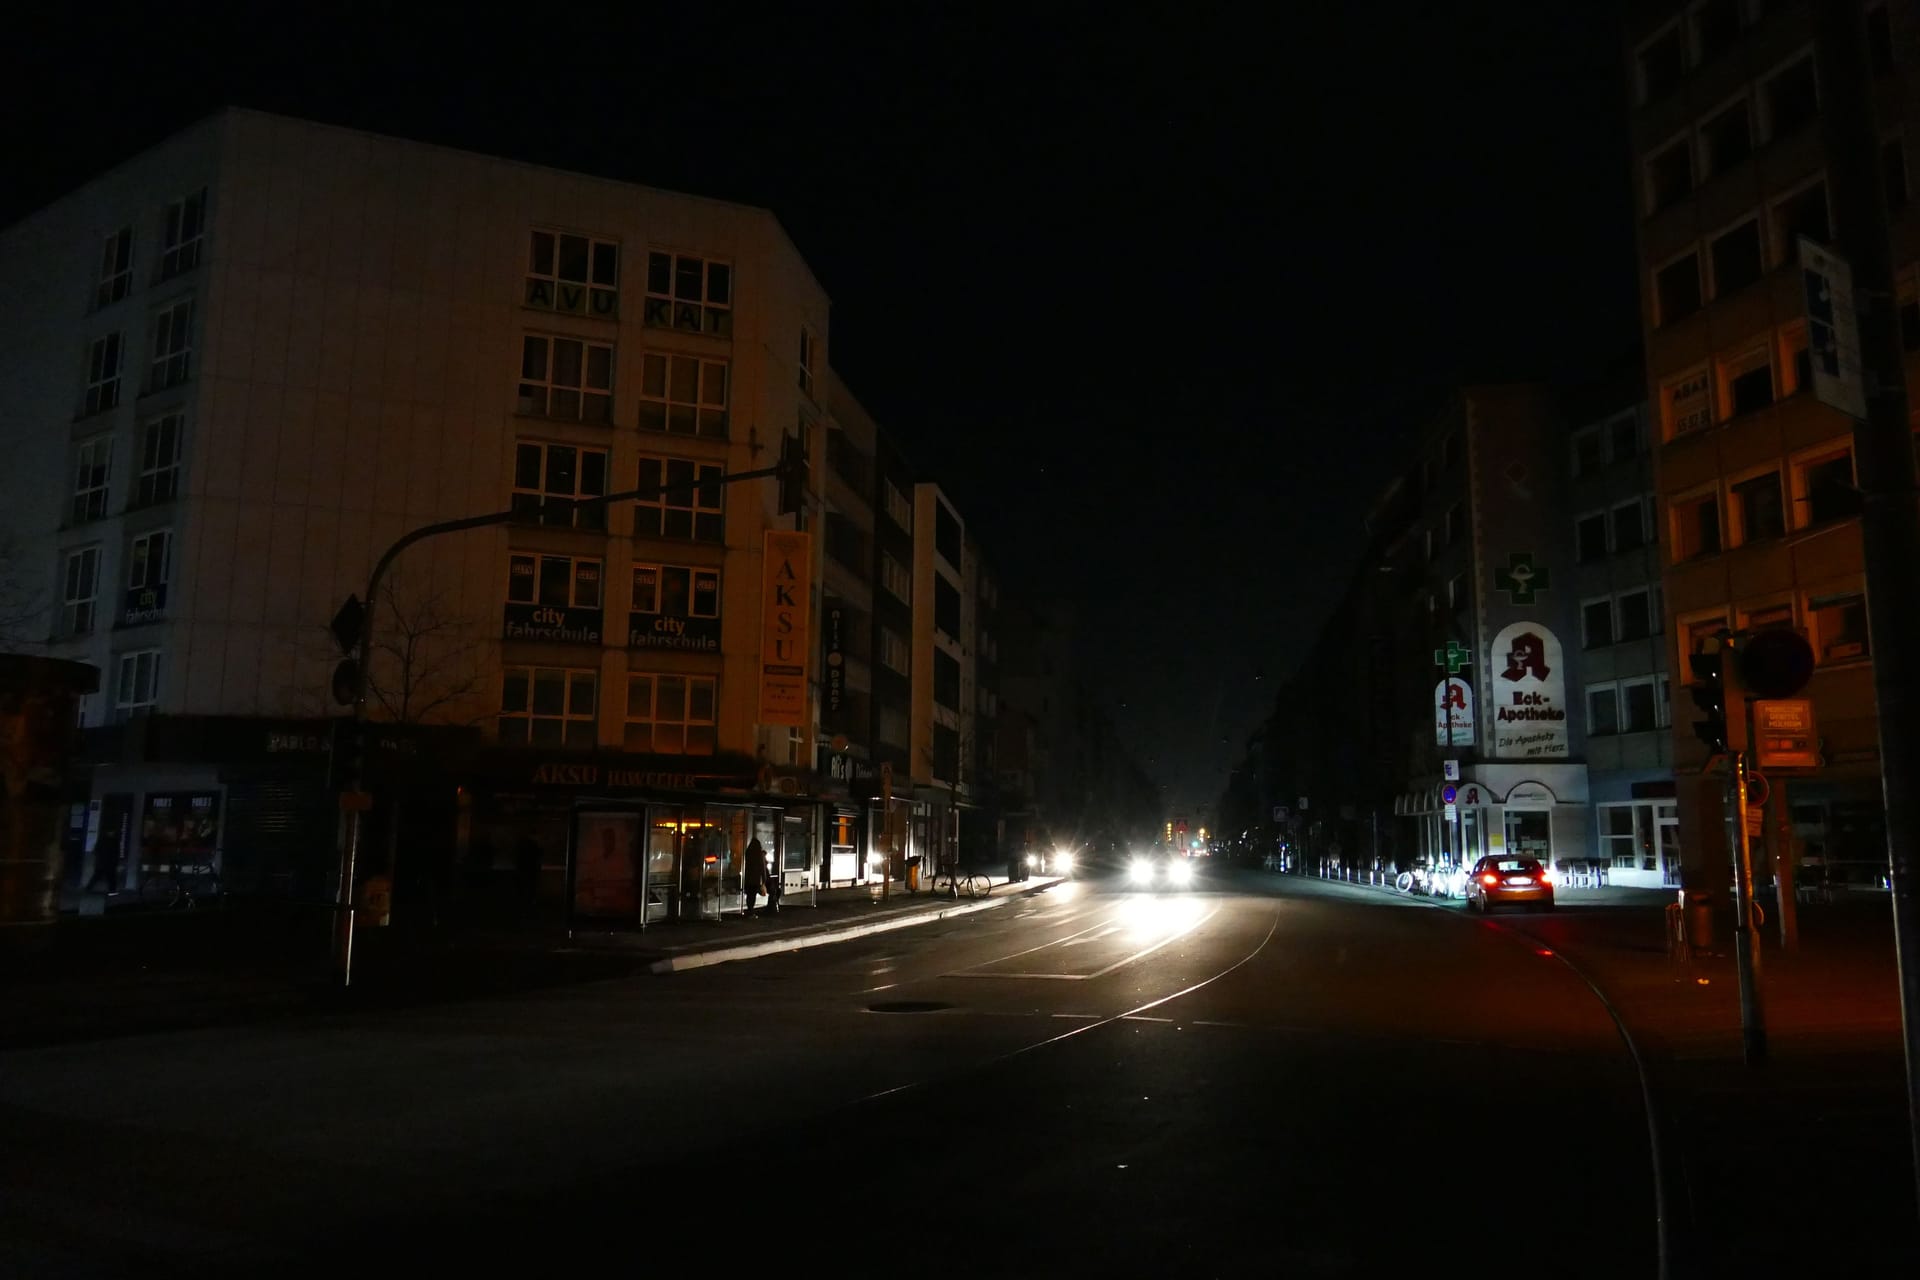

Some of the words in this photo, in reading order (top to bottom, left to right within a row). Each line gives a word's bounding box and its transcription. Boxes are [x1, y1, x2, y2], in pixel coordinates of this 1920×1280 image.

[532, 607, 567, 627] city
[776, 558, 796, 662] AKSU
[506, 621, 599, 644] fahrschule
[654, 615, 686, 635] city
[630, 629, 718, 650] fahrschule
[1512, 691, 1550, 706] Eck-
[1497, 707, 1565, 723] Apotheke
[531, 763, 598, 785] AKSU
